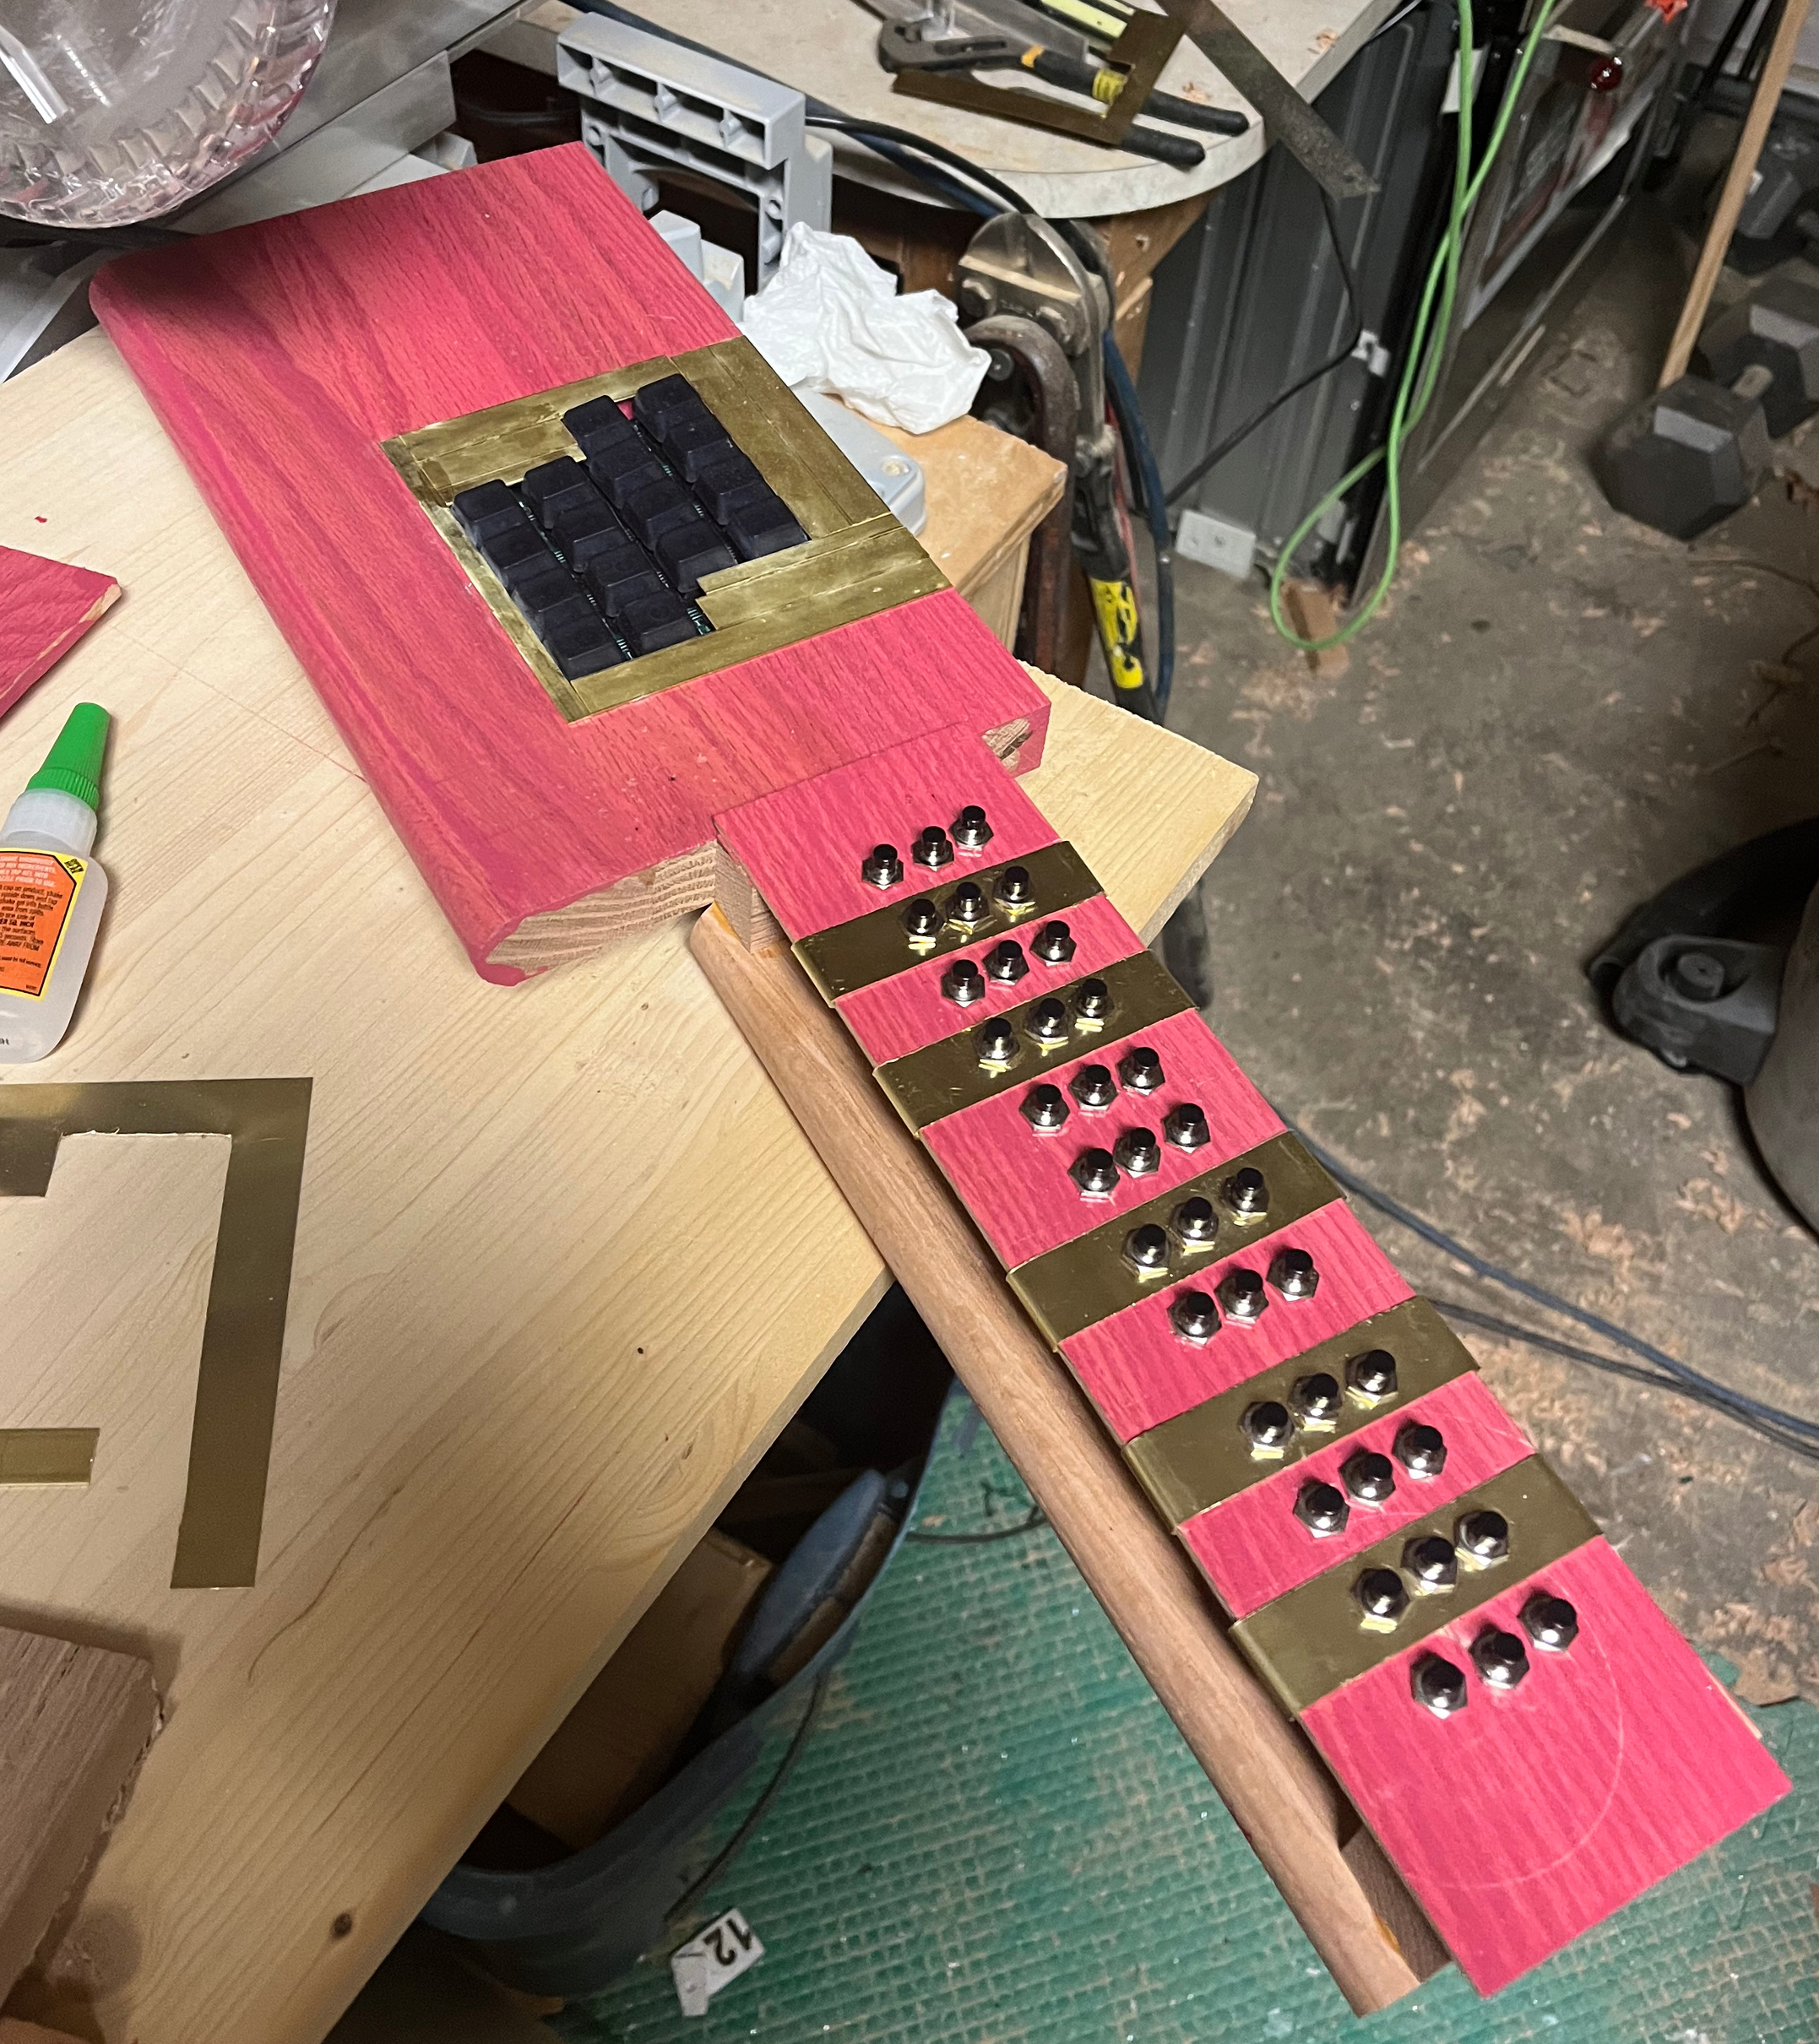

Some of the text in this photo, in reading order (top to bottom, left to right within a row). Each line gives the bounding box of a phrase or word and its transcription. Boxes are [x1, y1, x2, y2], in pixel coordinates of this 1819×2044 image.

[34, 870, 49, 879] INTO
[14, 876, 35, 884] PRIOR
[35, 877, 43, 886] TO
[46, 891, 62, 899] shake
[23, 941, 41, 951] FROM
[703, 1917, 752, 1967] 12
